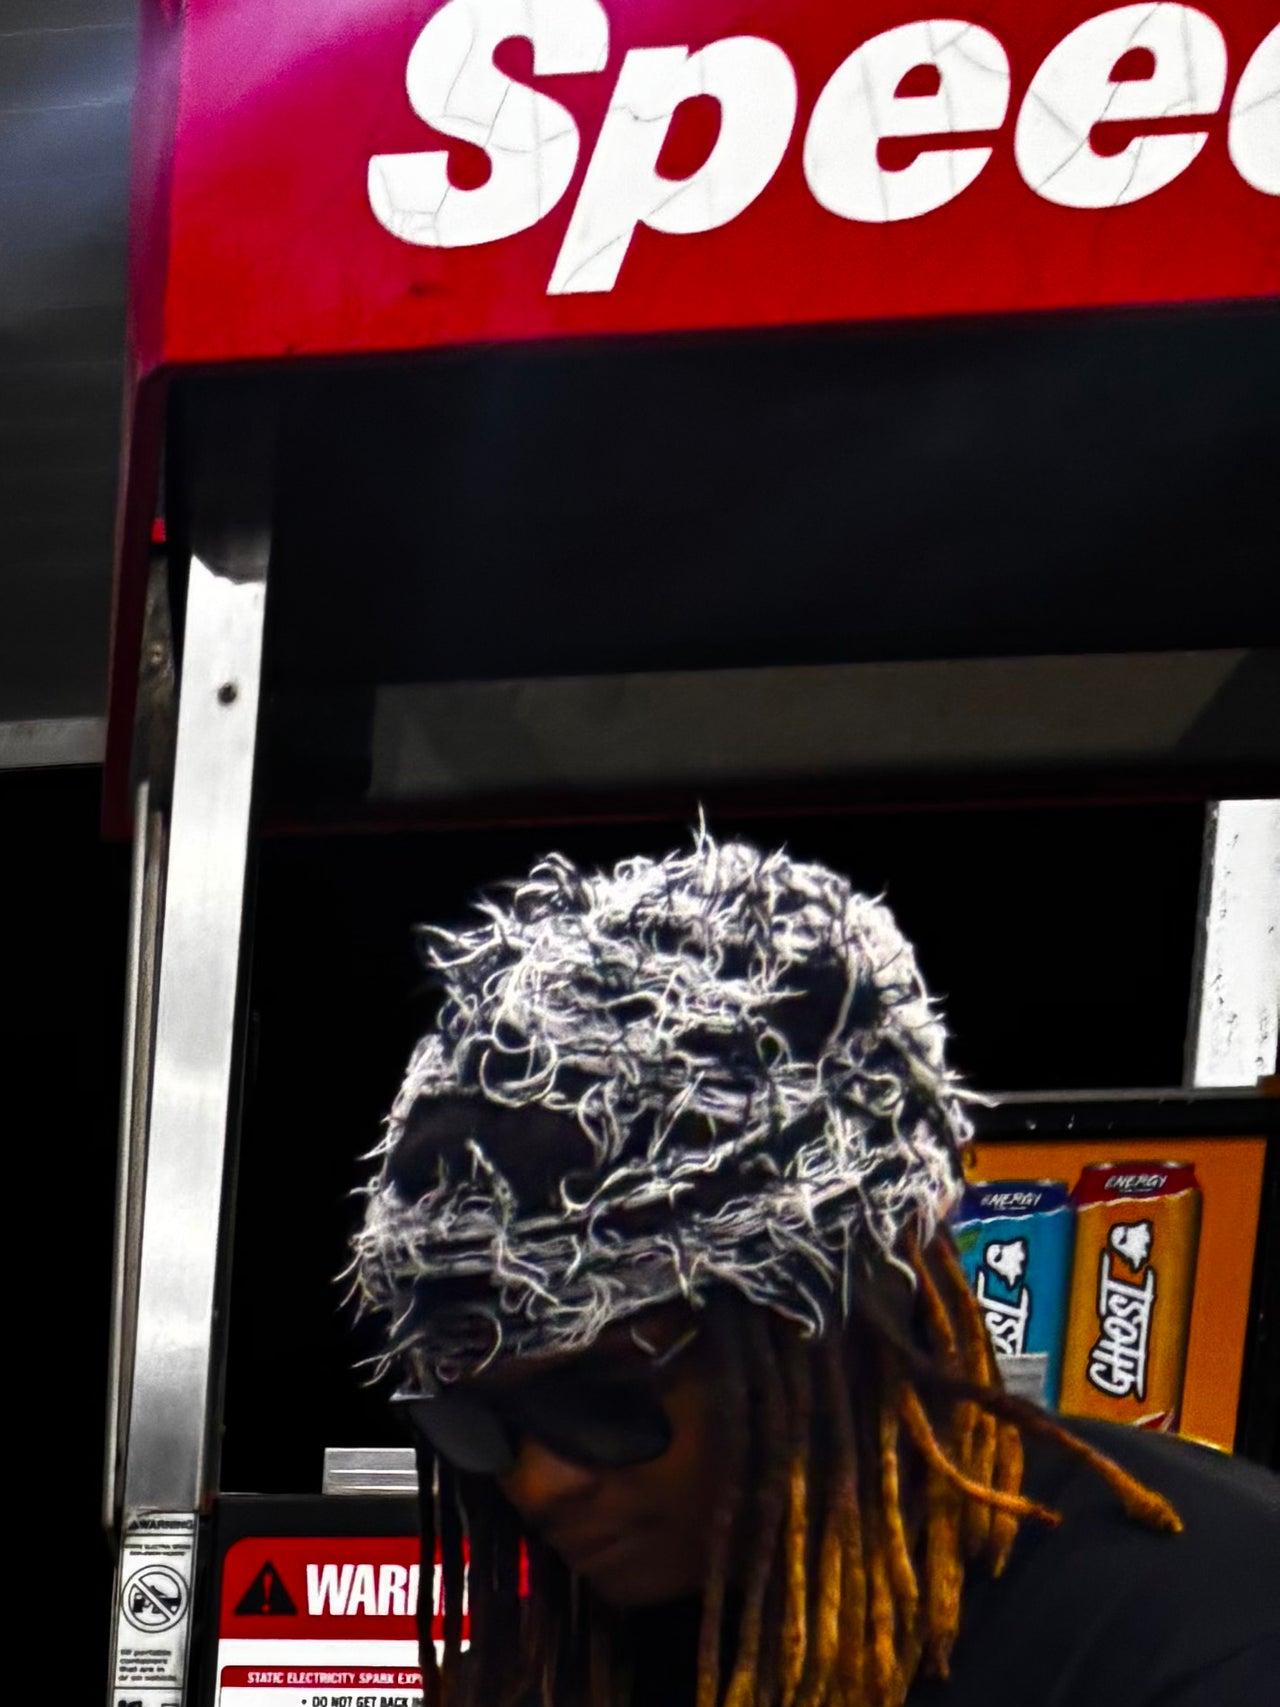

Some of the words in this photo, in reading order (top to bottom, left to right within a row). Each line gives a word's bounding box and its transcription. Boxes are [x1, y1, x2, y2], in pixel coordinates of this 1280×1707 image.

[1089, 1250, 1157, 1400] GHOST
[306, 1563, 444, 1616] WARN
[247, 1672, 284, 1685] STATIC
[286, 1672, 355, 1685] ELECTRICITY
[358, 1673, 395, 1685] SPARK
[397, 1672, 424, 1685] EXP
[312, 1696, 328, 1707] DO
[331, 1696, 353, 1707] NOT
[356, 1696, 377, 1707] GET
[380, 1697, 409, 1707] BACK
